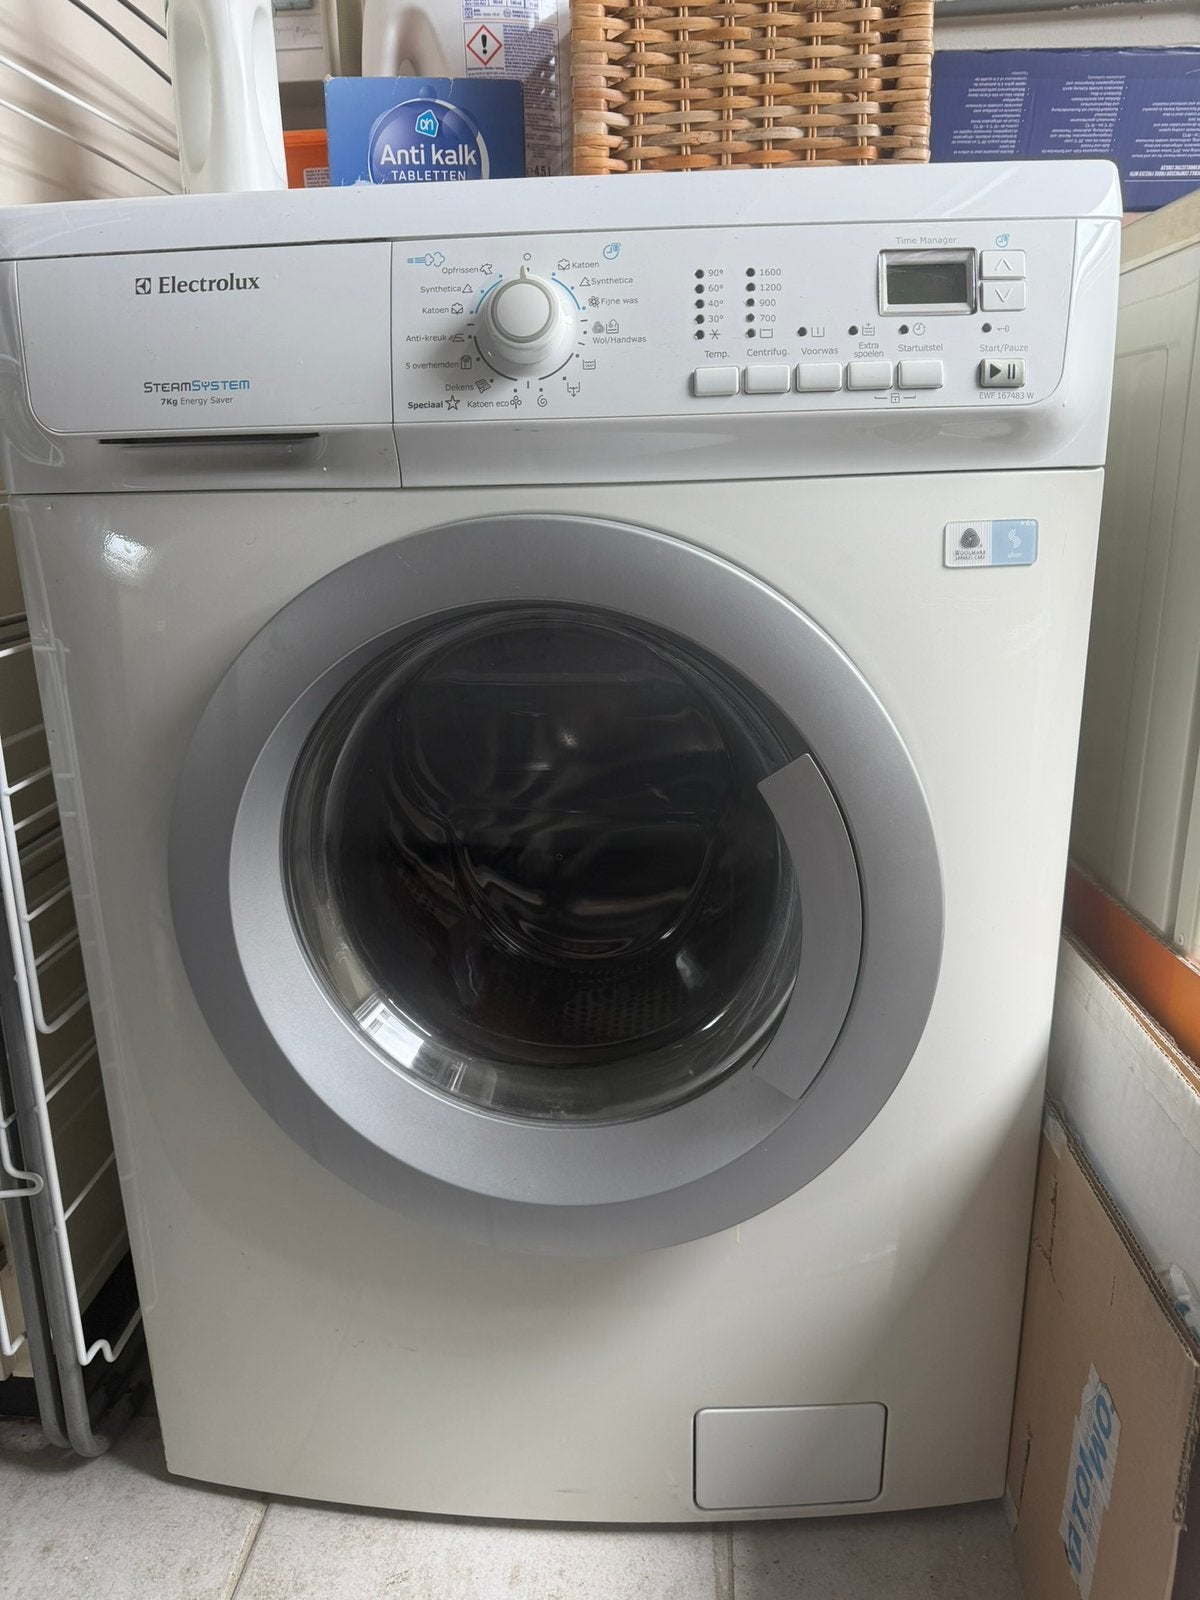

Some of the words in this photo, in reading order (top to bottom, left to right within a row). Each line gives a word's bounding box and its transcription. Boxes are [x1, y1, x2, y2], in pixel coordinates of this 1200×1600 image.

[380, 144, 426, 166] Anti
[431, 143, 478, 166] kalk
[391, 170, 467, 182] TABLETTEN
[896, 236, 917, 245] Time
[920, 235, 958, 246] Manager
[441, 266, 479, 275] Opfrissen
[759, 268, 782, 276] 1600
[158, 273, 261, 294] Electrolux
[591, 276, 634, 285] Synthetica
[420, 285, 462, 294] Synthetica
[759, 283, 782, 291] 1200
[601, 297, 621, 306] Fijne
[622, 297, 639, 305] was
[759, 298, 777, 307] 900
[422, 306, 450, 314] Katoen
[759, 313, 777, 322] 700
[406, 334, 447, 342] Anti-kreuk
[592, 335, 647, 345] Wol/Handwas
[858, 342, 879, 350] Extra
[898, 343, 944, 352] Startuitstel
[979, 344, 1030, 353] Start/Pauze
[704, 350, 730, 359] Temp.
[746, 348, 790, 358] Centrifug.
[801, 347, 839, 355] Voorwas
[853, 350, 885, 358] spoelen
[412, 361, 460, 369] overhemden
[445, 383, 475, 392] Dekens
[160, 397, 178, 407] 7Kg
[180, 396, 208, 407] Energy
[210, 395, 233, 405] Saver
[407, 400, 444, 409] Speciaal
[467, 400, 494, 408] Katoen
